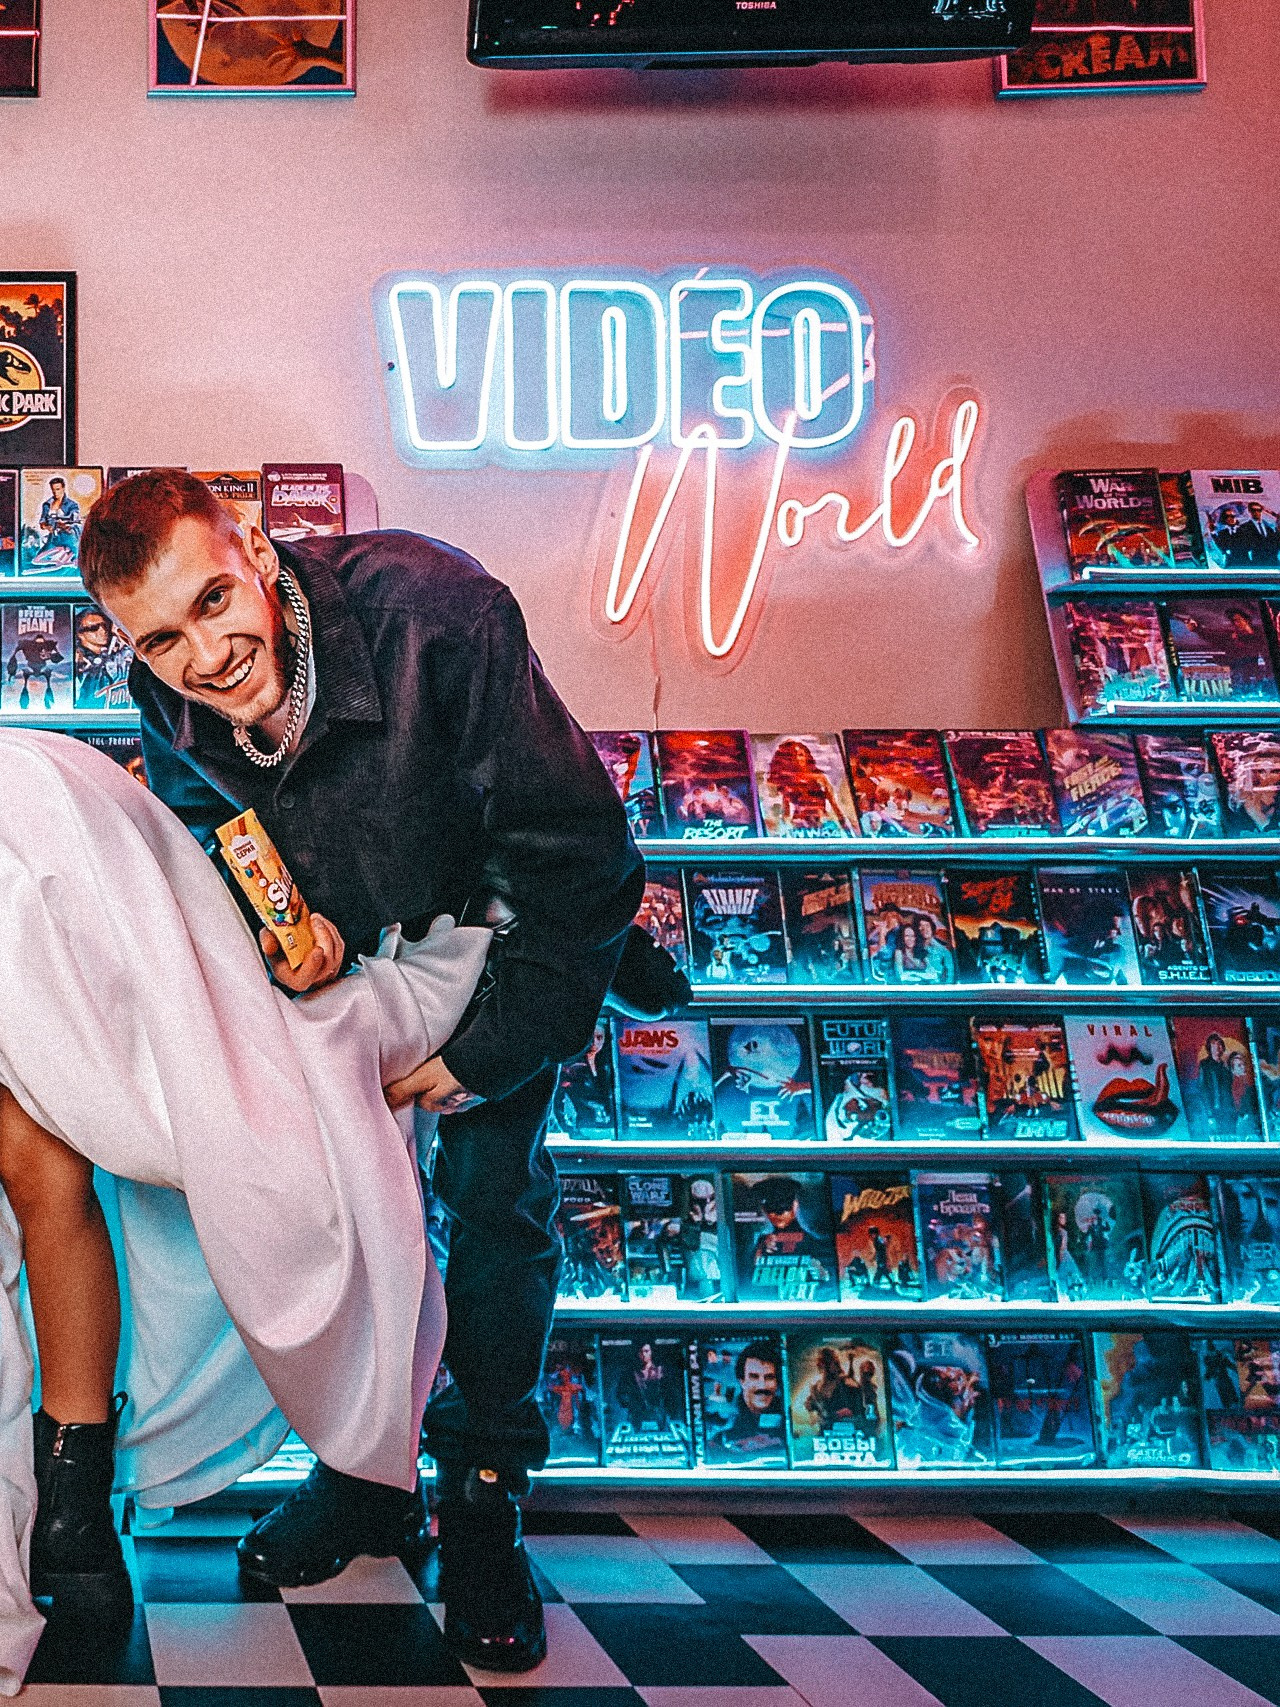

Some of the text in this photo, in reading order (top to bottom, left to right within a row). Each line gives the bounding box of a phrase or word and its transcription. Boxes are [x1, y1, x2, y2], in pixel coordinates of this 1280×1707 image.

[389, 281, 864, 450] VIDEO
[12, 391, 57, 414] PARK
[223, 484, 246, 493] KING
[1209, 477, 1264, 495] MIB
[605, 398, 980, 657] World
[17, 617, 55, 636] GIANT
[704, 818, 723, 828] THE
[682, 825, 748, 840] RESORT
[1158, 970, 1211, 980] S.H.I.E.L.
[619, 1028, 679, 1049] JAWS
[1087, 1024, 1153, 1037] VIRAL
[812, 1437, 877, 1451] БОБЫ
